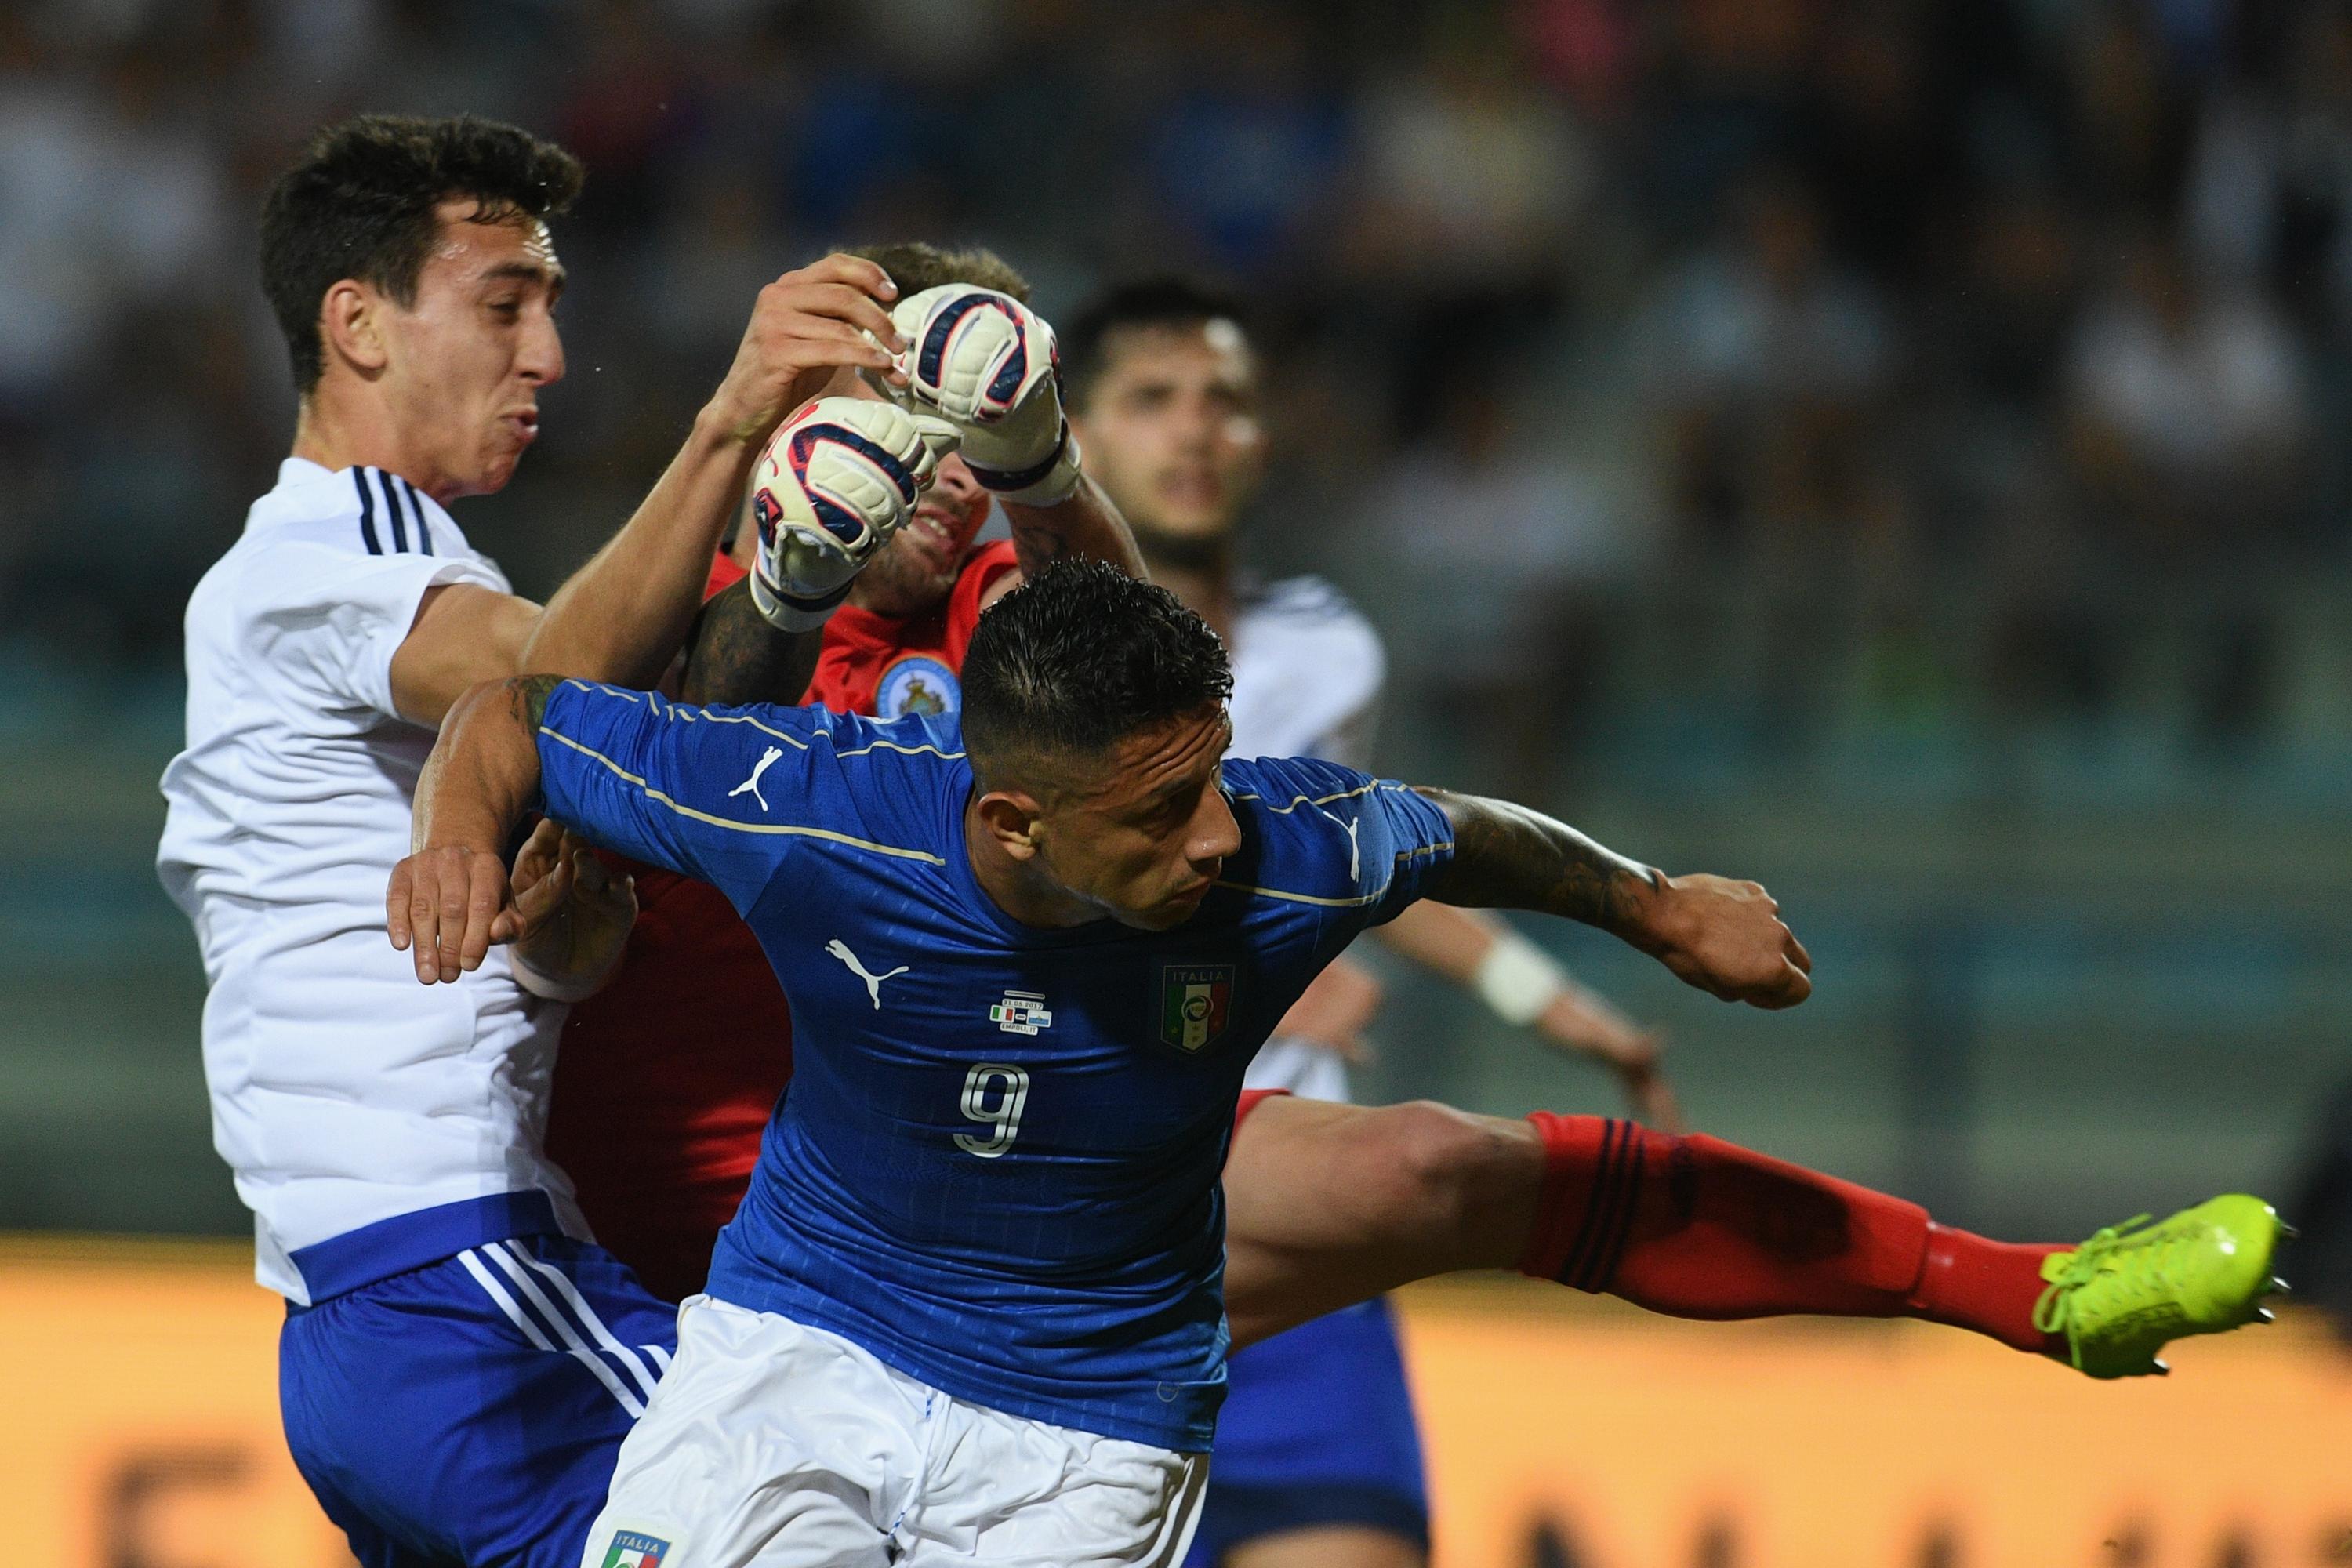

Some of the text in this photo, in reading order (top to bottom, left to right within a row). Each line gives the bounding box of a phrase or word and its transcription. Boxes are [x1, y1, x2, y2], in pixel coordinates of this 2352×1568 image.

[1173, 971, 1224, 982] ITALIA
[953, 1062, 1029, 1158] 9
[616, 1535, 659, 1553] ITALIA
